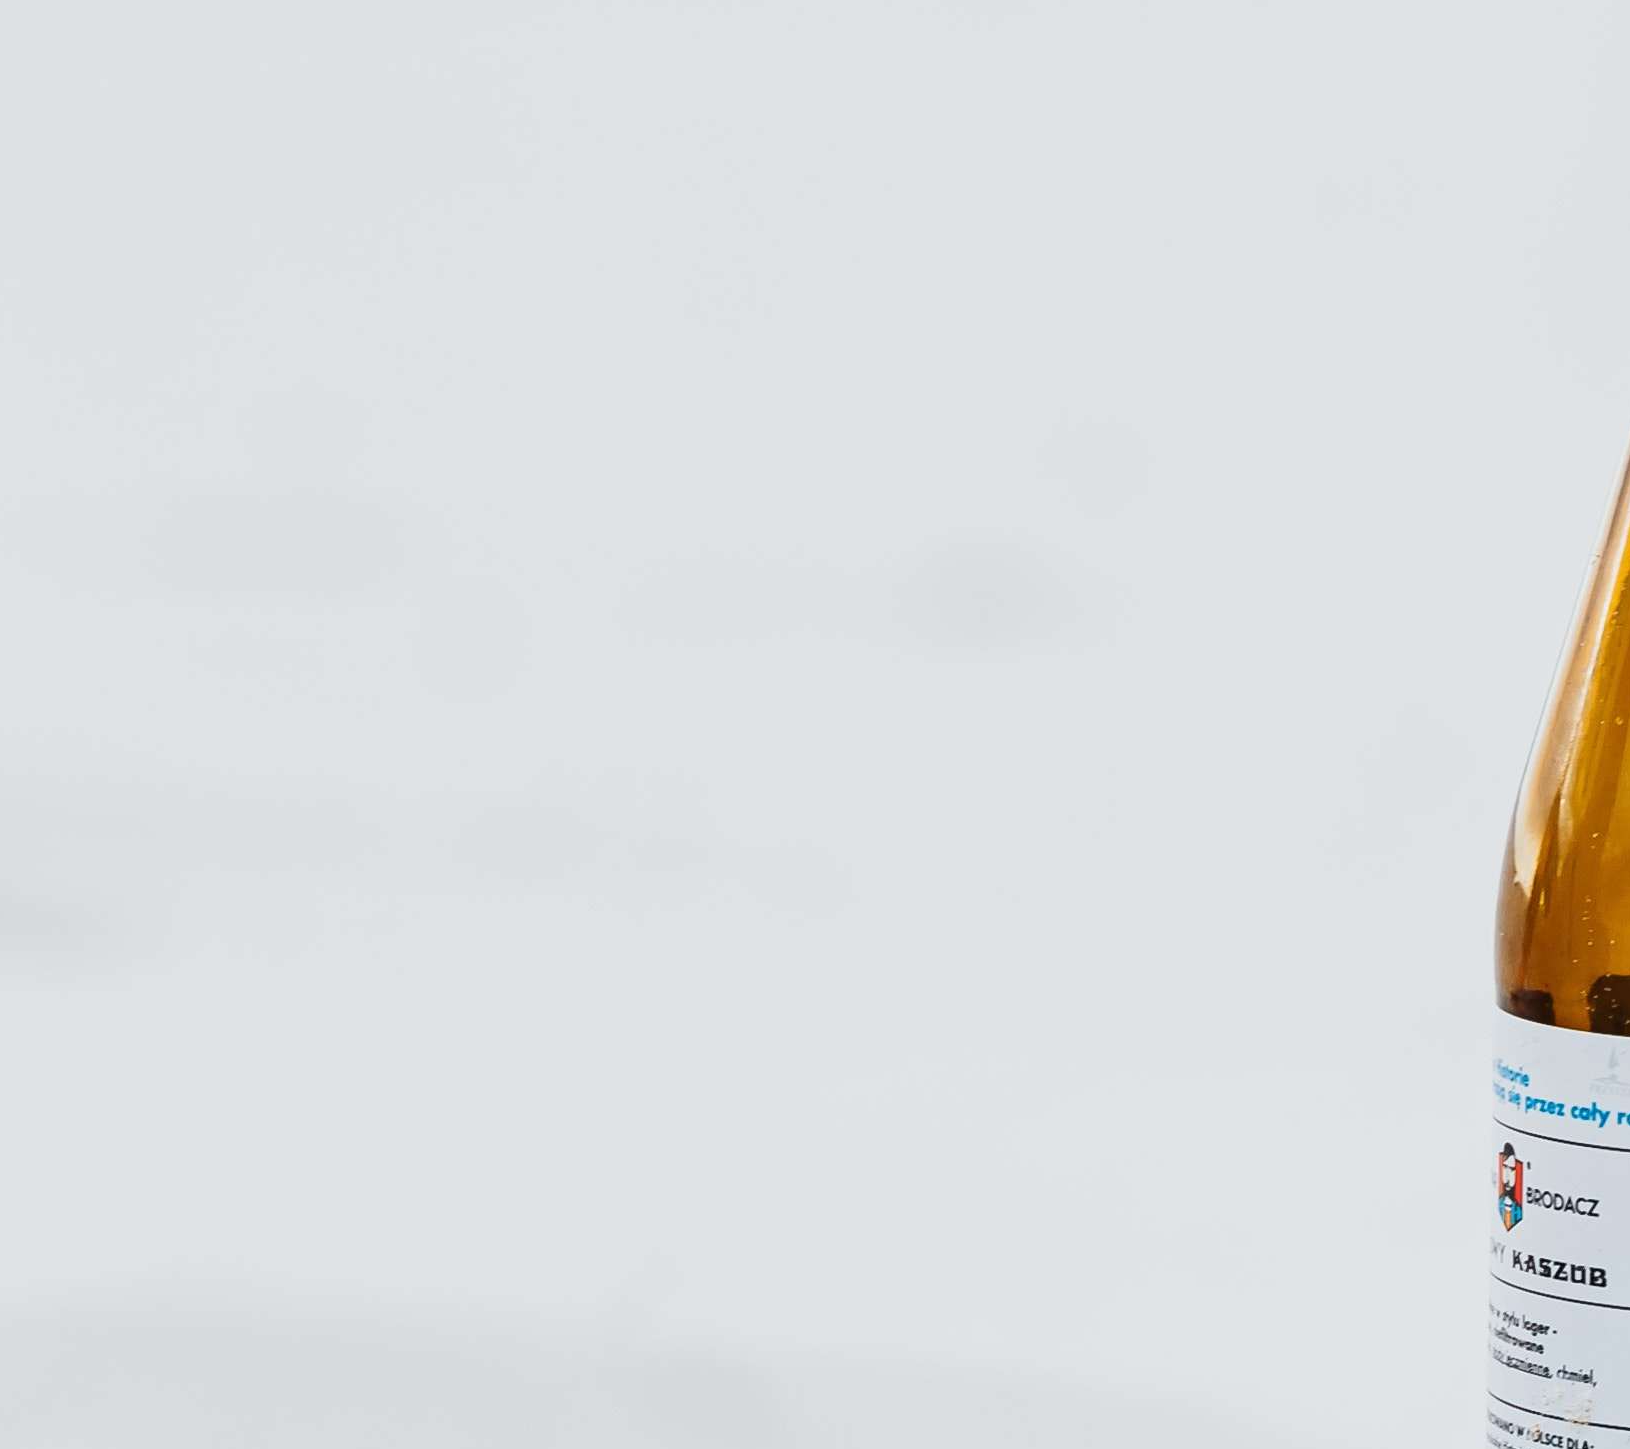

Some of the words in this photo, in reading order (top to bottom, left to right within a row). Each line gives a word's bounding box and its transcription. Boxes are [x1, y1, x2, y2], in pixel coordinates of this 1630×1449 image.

[1525, 1095, 1565, 1114] przez
[1570, 1102, 1610, 1128] cały
[1526, 1187, 1601, 1218] BRODACZ
[1522, 1314, 1551, 1336] lager
